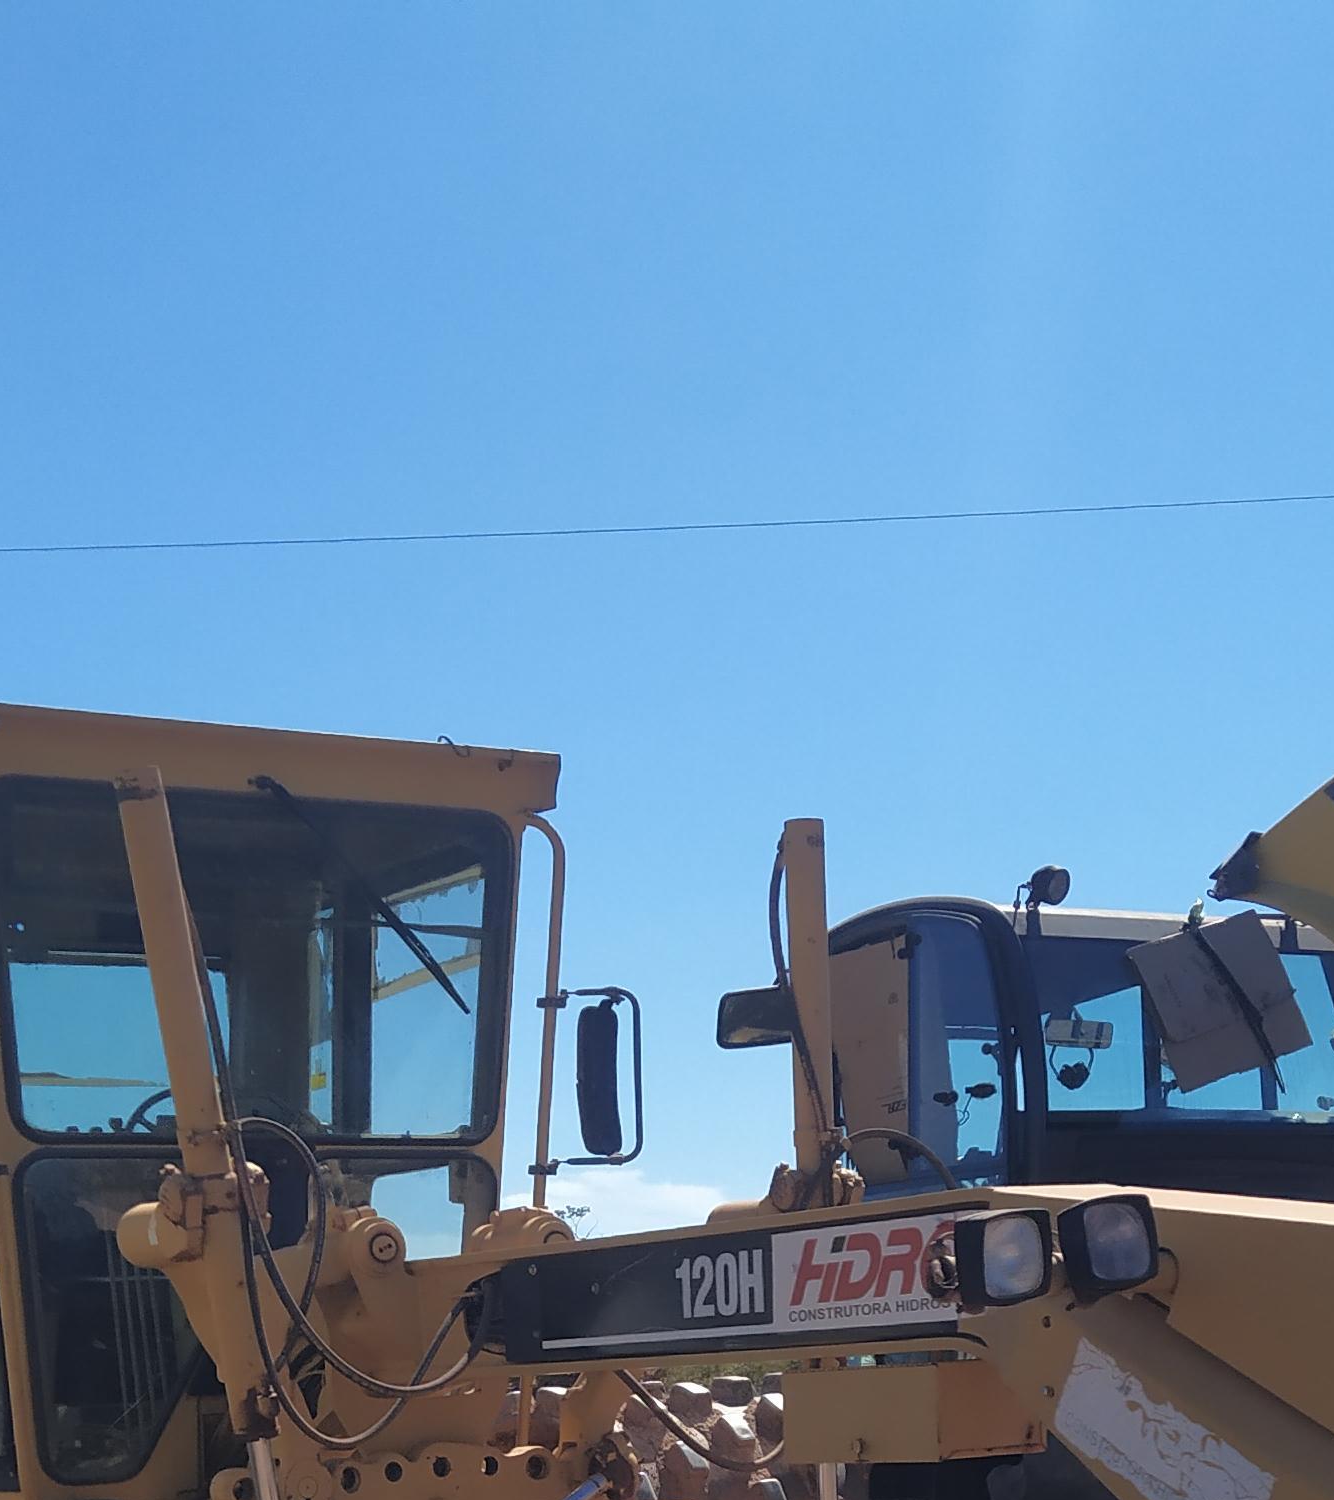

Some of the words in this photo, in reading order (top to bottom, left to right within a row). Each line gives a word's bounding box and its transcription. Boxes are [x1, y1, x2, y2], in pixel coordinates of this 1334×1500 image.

[675, 1248, 765, 1320] 120H
[788, 1301, 892, 1323] CONSTRUTORA
[895, 1297, 951, 1314] HIDROS
